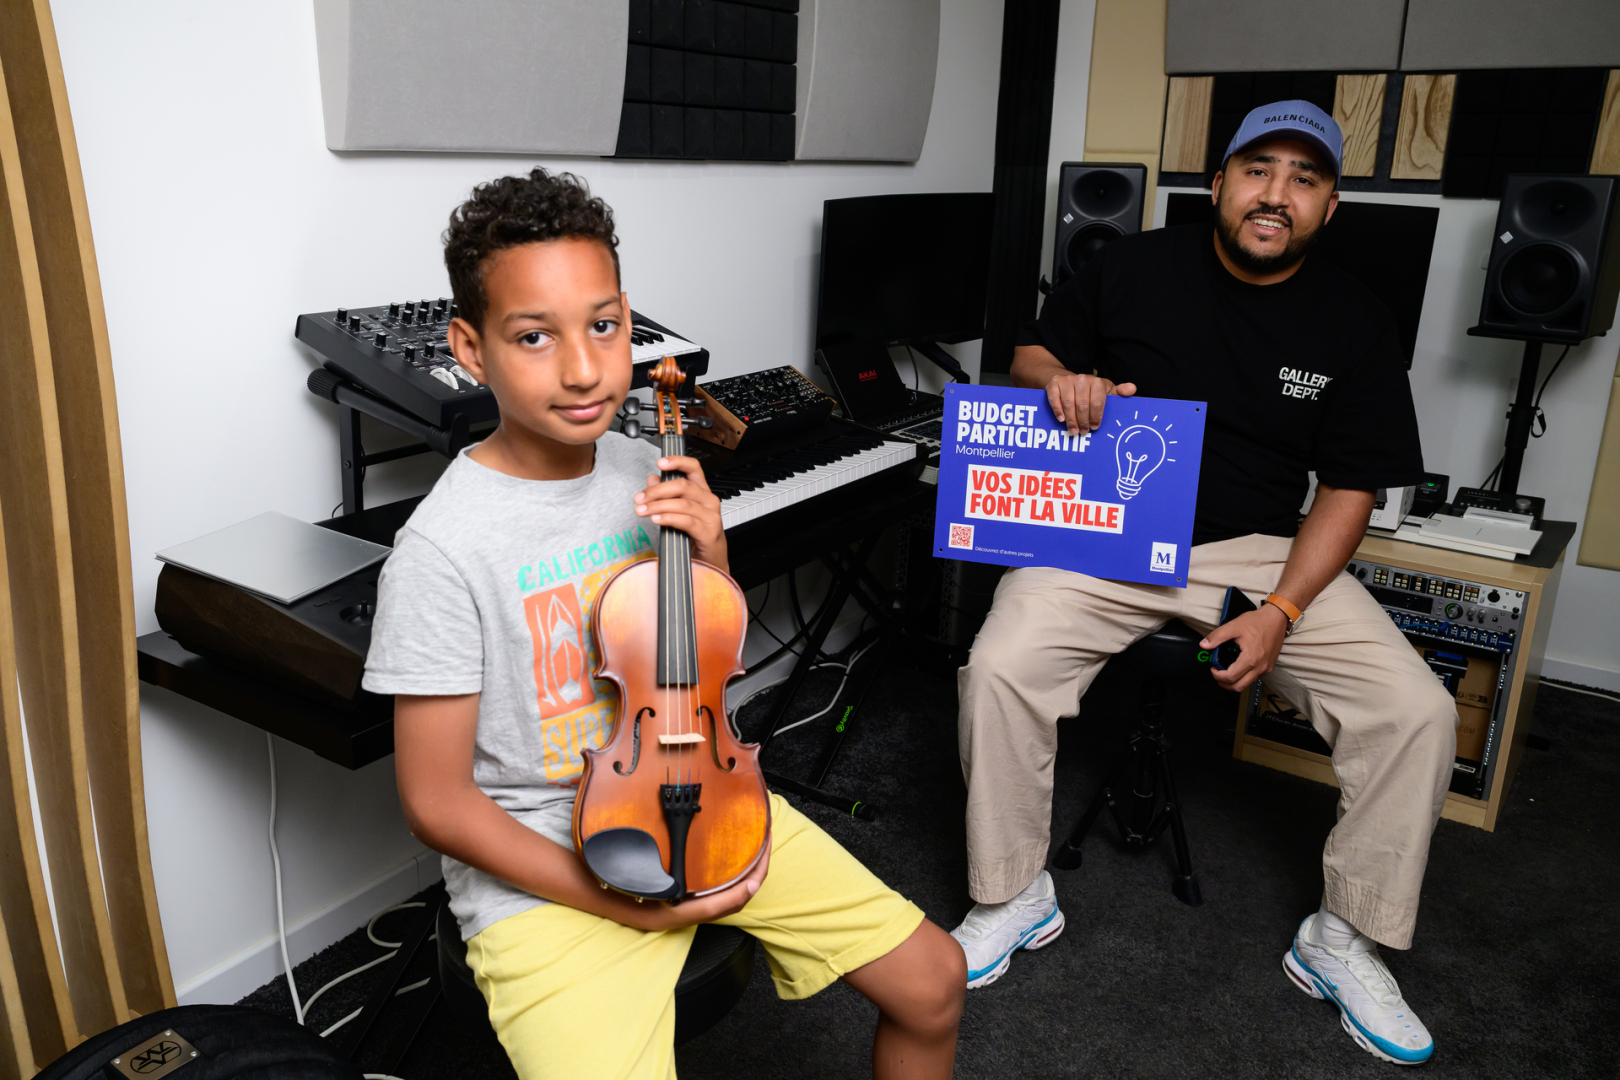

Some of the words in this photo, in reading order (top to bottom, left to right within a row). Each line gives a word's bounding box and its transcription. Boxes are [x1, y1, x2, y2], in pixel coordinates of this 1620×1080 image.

[1263, 114, 1326, 133] BALENCIAGA
[858, 370, 877, 381] AKAI
[1281, 382, 1321, 401] DEPT.
[958, 400, 1038, 426] BUDGET
[956, 422, 1092, 453] PARTICIPATIF
[955, 444, 1015, 459] Montpellier
[971, 469, 1012, 494] VOS
[1018, 471, 1077, 500] IDÉES
[970, 493, 1025, 519] FONT
[1029, 498, 1055, 522] LA
[1062, 502, 1119, 529] VILLE
[517, 525, 651, 592] CALIFORNIA
[975, 546, 998, 554] Découvrez
[1155, 551, 1171, 565] M
